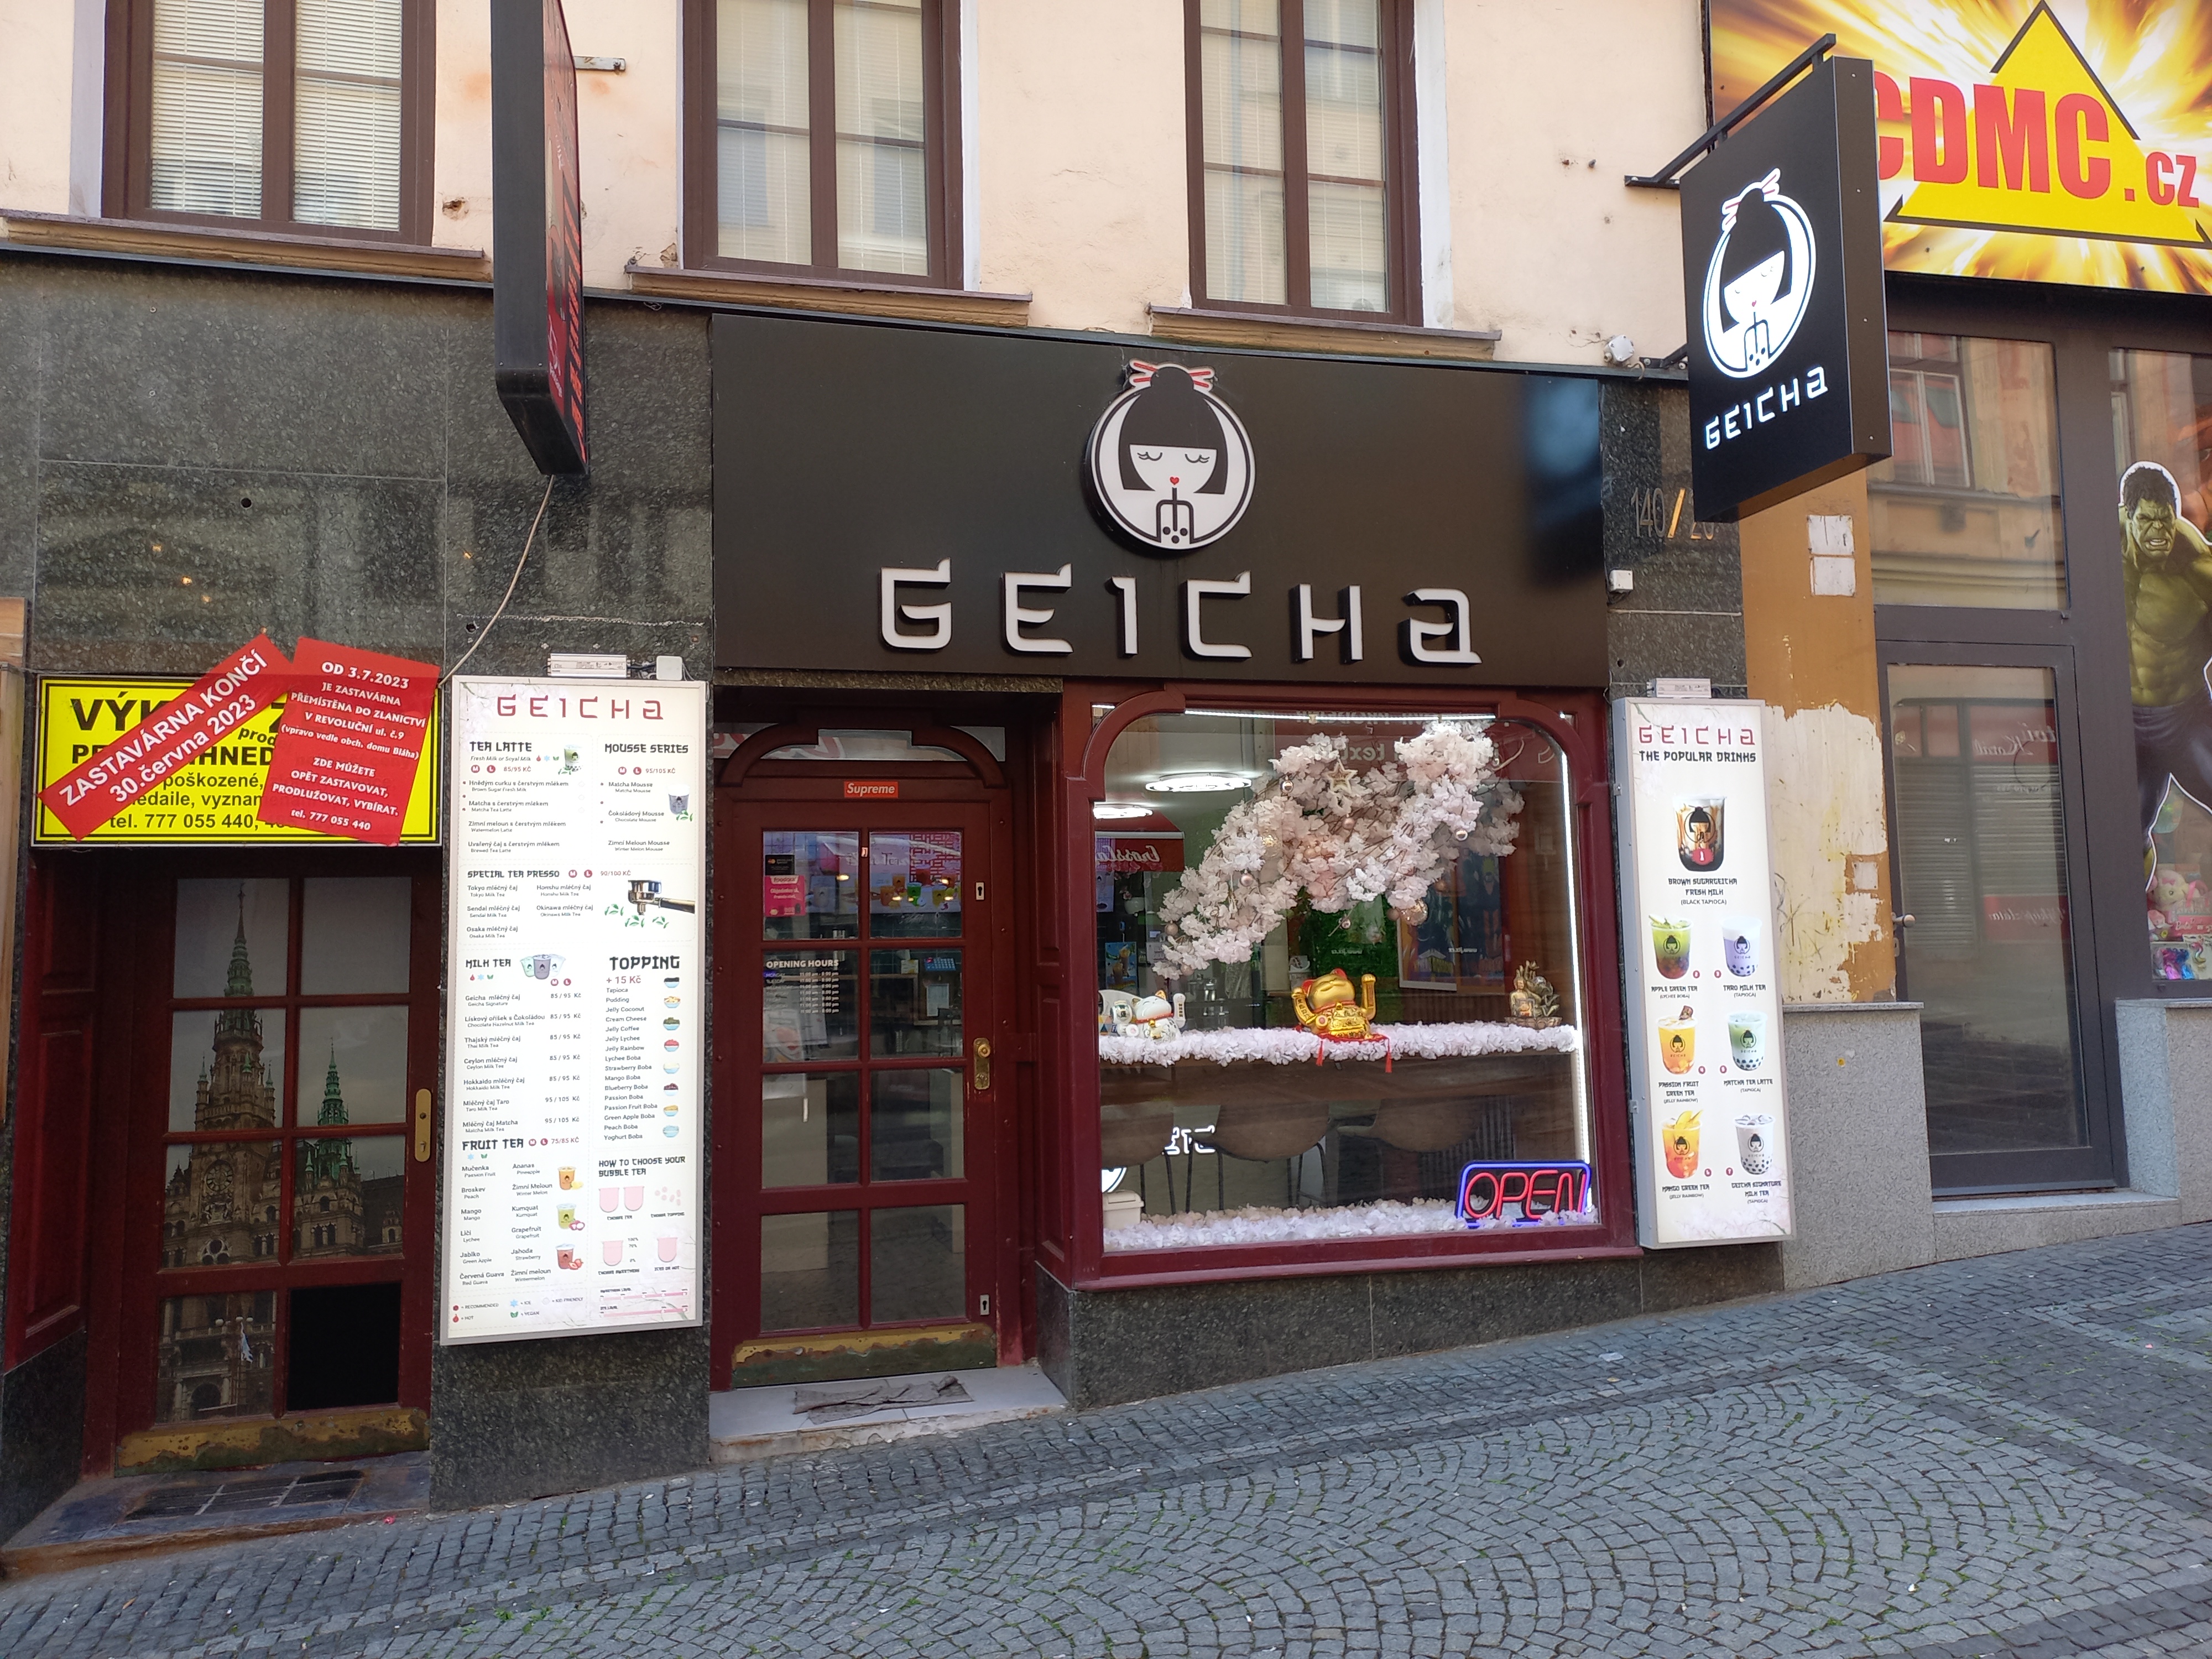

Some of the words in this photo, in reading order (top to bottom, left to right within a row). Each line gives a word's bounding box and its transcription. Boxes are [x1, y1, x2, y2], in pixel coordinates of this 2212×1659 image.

[1705, 366, 1828, 450] GEICHA
[1631, 487, 1714, 540] 140/
[880, 559, 1483, 666] GEICHA
[322, 661, 343, 675] OD
[348, 666, 409, 689] 3.7.2023
[291, 692, 353, 713] PŘEMÍSTĚNA
[354, 706, 371, 716] DO
[321, 682, 332, 692] JE
[335, 685, 401, 706] ZASTAVÁRNA
[214, 694, 257, 735] 2023
[498, 693, 663, 720] GEICHA
[59, 702, 205, 806] ZASTAVÁRNA
[200, 648, 267, 708] KONČÍ
[305, 712, 312, 721] V
[315, 714, 374, 734] REVOLUČNÍ
[375, 727, 387, 737] ul.
[389, 729, 404, 740] č.9
[1639, 725, 1755, 745] GEICHA
[281, 724, 314, 738] (vpravo
[316, 732, 338, 743] vedle
[341, 737, 363, 748] obch.
[367, 743, 390, 754] domu
[393, 747, 419, 761] Bláha)
[469, 741, 492, 752] TEA
[495, 742, 532, 753] LATTE
[604, 744, 646, 754] MOUSSE
[650, 744, 689, 754] SERIES
[189, 746, 274, 765] HNED
[1639, 750, 1660, 762] THE
[1663, 751, 1713, 763] POPULAR
[313, 757, 332, 769] ZDE
[335, 760, 375, 778] MŮŽETE
[163, 773, 263, 791] poškozené,
[290, 769, 317, 783] OPĚT
[320, 776, 388, 798] ZASTAVOVAT,
[847, 782, 895, 796] Supreme
[132, 791, 195, 809] edaile,
[272, 783, 351, 807] PRODLUŽOVAT,
[354, 799, 399, 817] VYBÍRAT.
[110, 816, 137, 829] tel.
[145, 813, 177, 828] 777
[183, 813, 216, 829] 055
[221, 813, 259, 831] 440,
[291, 809, 305, 819] tel.
[309, 811, 328, 822] 777
[331, 815, 348, 826] 055
[352, 819, 371, 831] 440
[526, 870, 560, 878] PRESSO
[609, 955, 680, 971] TOPPING
[766, 959, 806, 968] OPENING
[615, 977, 627, 985] 15
[629, 975, 641, 985] Kč
[462, 1139, 498, 1151] FRUIT
[502, 1138, 523, 1149] TEA
[598, 1159, 617, 1168] HOW
[619, 1158, 629, 1166] TO
[632, 1157, 662, 1166] CHOOSE
[1464, 1168, 1587, 1219] OPEN
